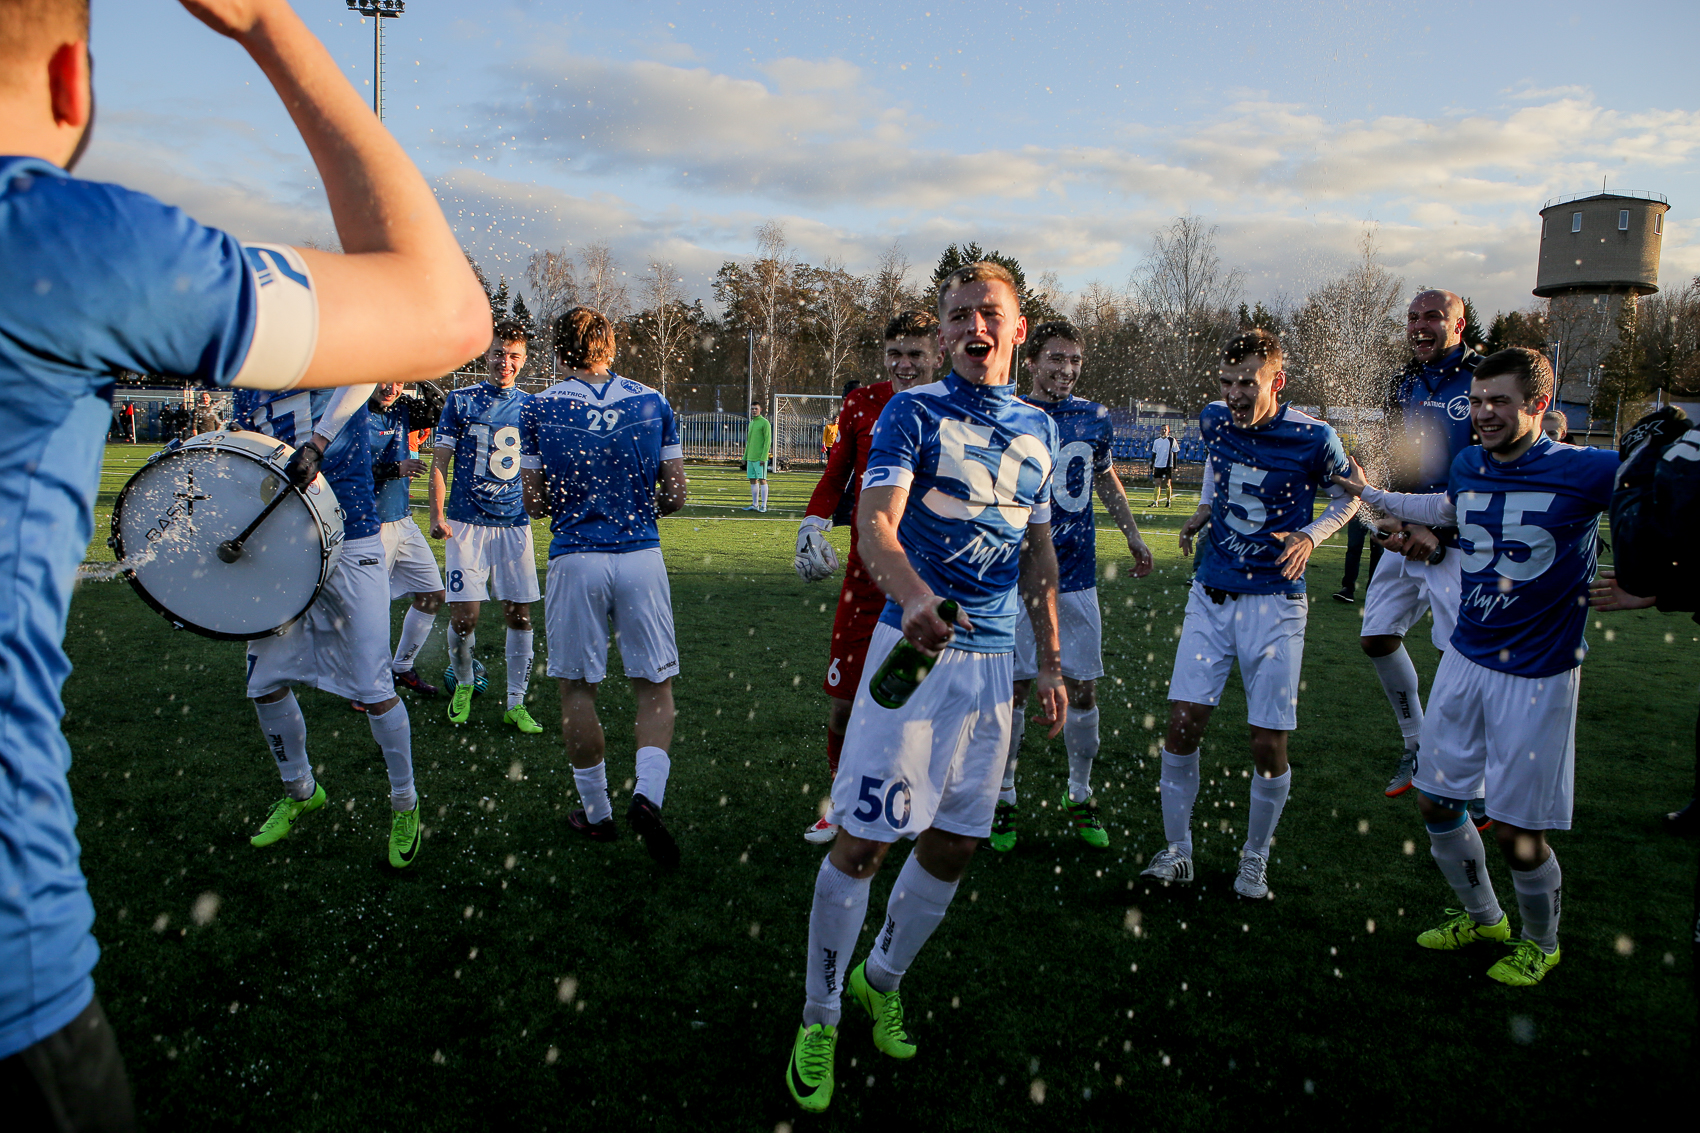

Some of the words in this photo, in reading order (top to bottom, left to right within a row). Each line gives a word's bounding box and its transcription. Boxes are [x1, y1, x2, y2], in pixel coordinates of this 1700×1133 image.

[558, 390, 588, 400] PATRICK
[586, 409, 619, 431] 29
[1424, 401, 1446, 409] PATRICK
[467, 424, 522, 481] 18
[922, 417, 1052, 530] 50
[1050, 441, 1094, 513] 0
[1224, 462, 1269, 536] 5
[1455, 491, 1557, 582] 55
[852, 774, 912, 830] 50
[824, 957, 838, 994] PATRICK
